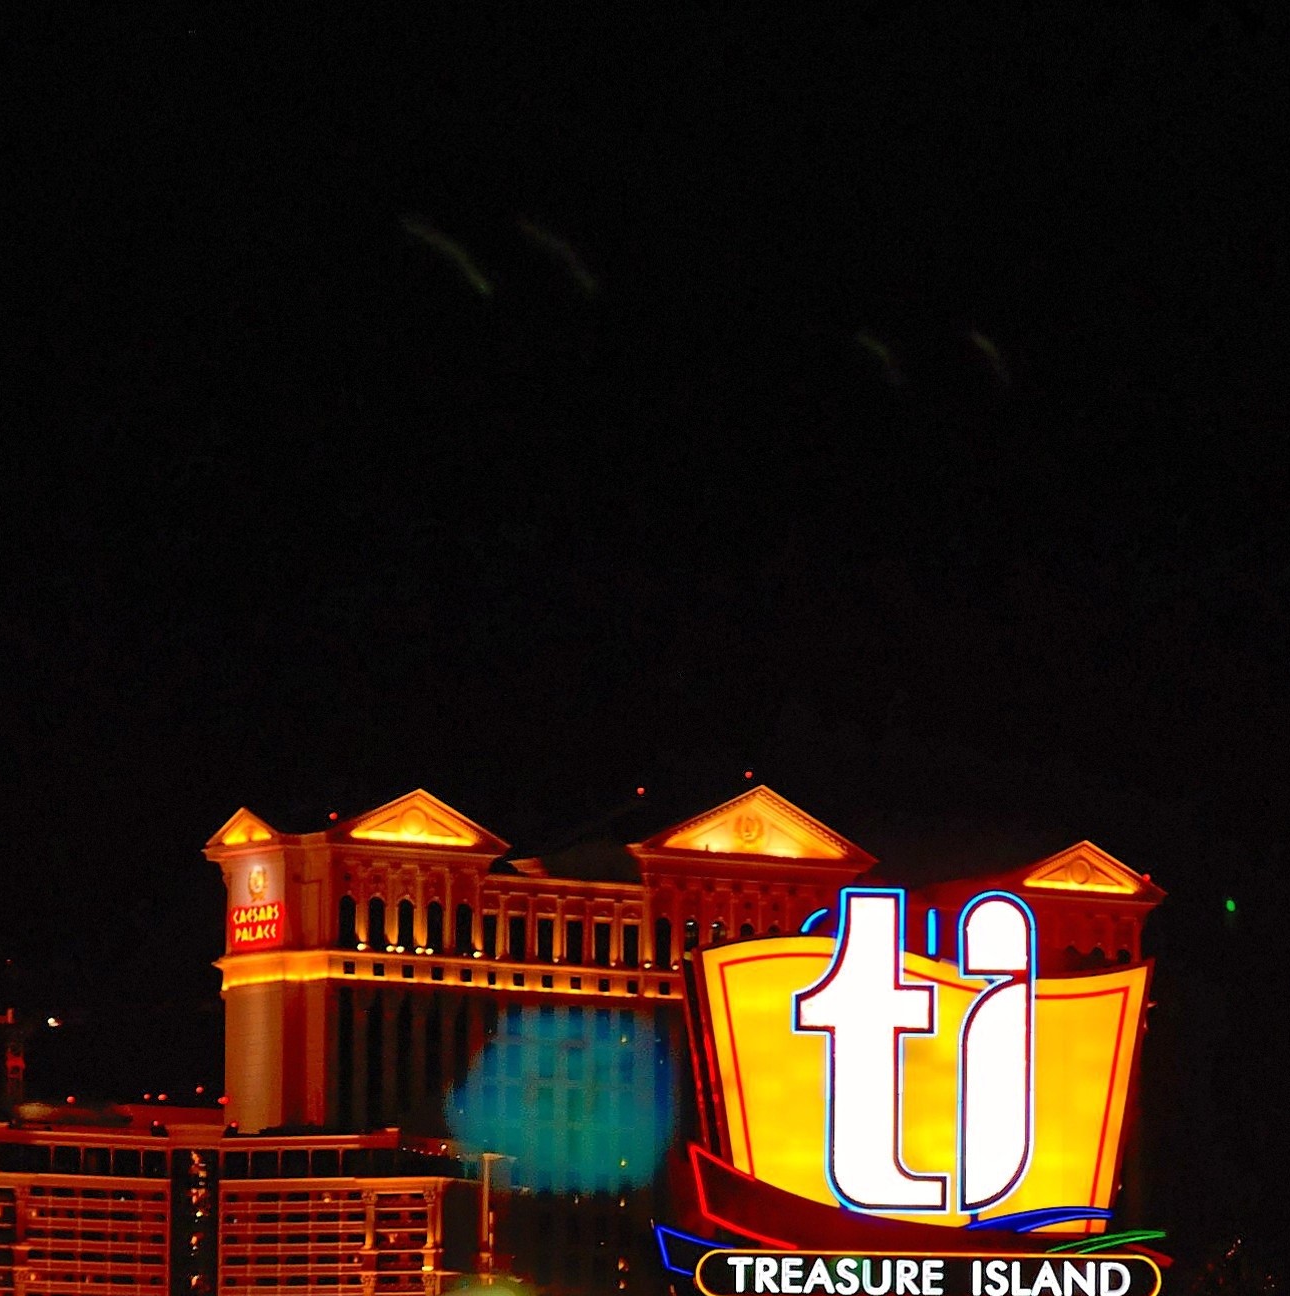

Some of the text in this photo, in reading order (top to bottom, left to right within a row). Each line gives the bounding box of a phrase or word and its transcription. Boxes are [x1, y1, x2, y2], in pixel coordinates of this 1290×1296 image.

[232, 904, 280, 925] CAESARS
[234, 923, 277, 944] PALACE
[727, 1256, 944, 1296] TREASURE
